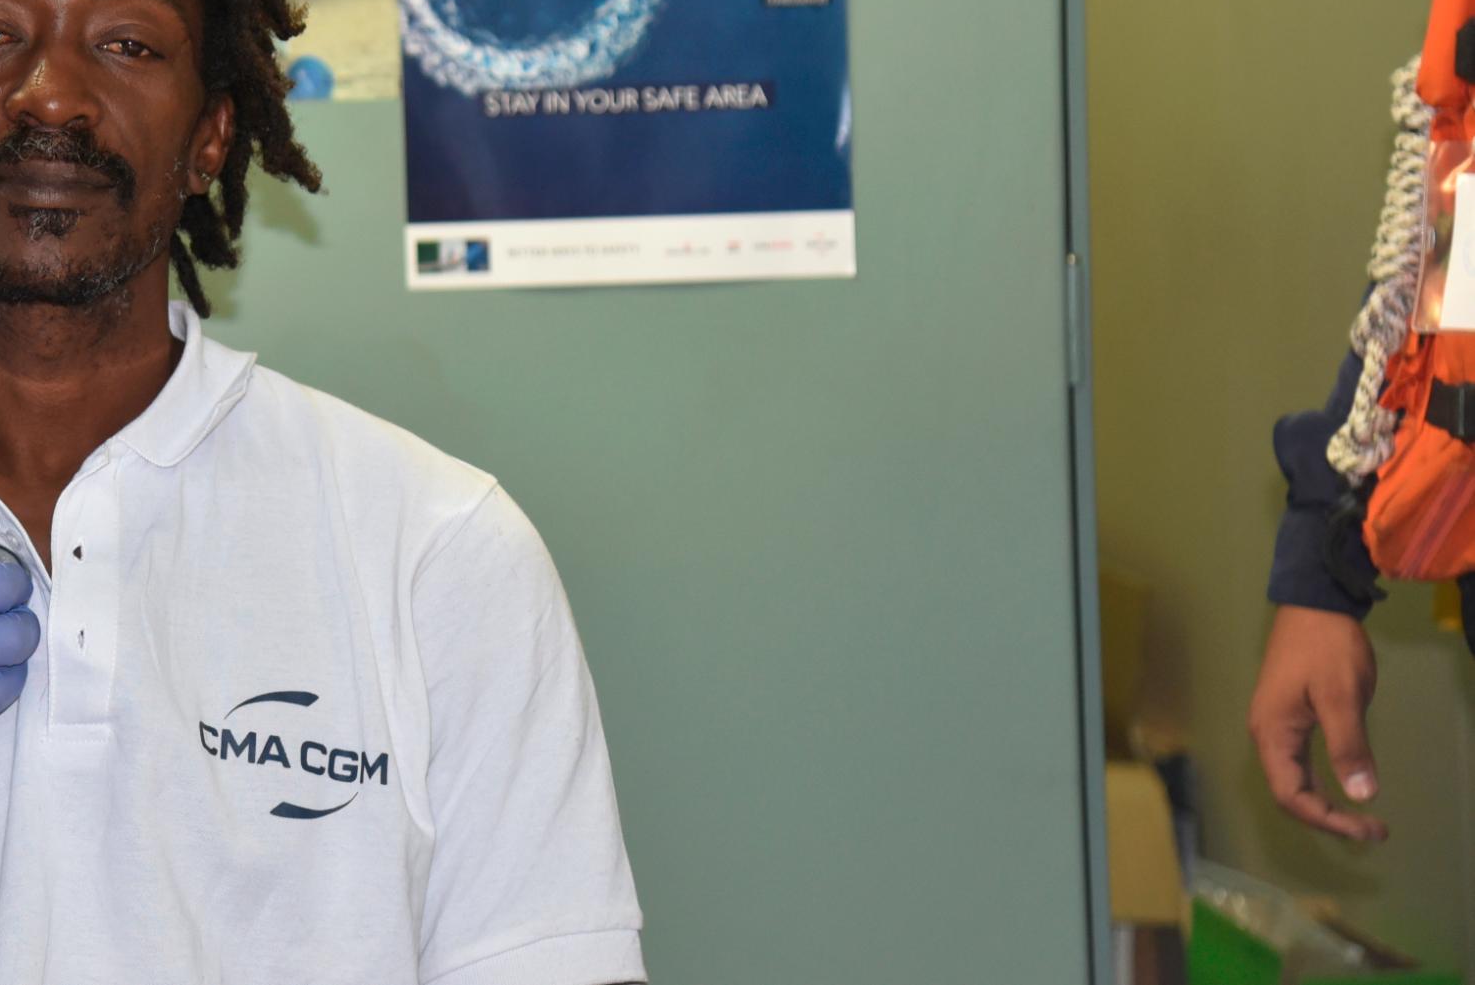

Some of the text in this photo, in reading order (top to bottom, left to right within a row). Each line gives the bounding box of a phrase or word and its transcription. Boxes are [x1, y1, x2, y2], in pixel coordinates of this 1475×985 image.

[483, 82, 769, 117] STAY IN YOUR SAFE AREA
[198, 719, 390, 786] CMA CGM
